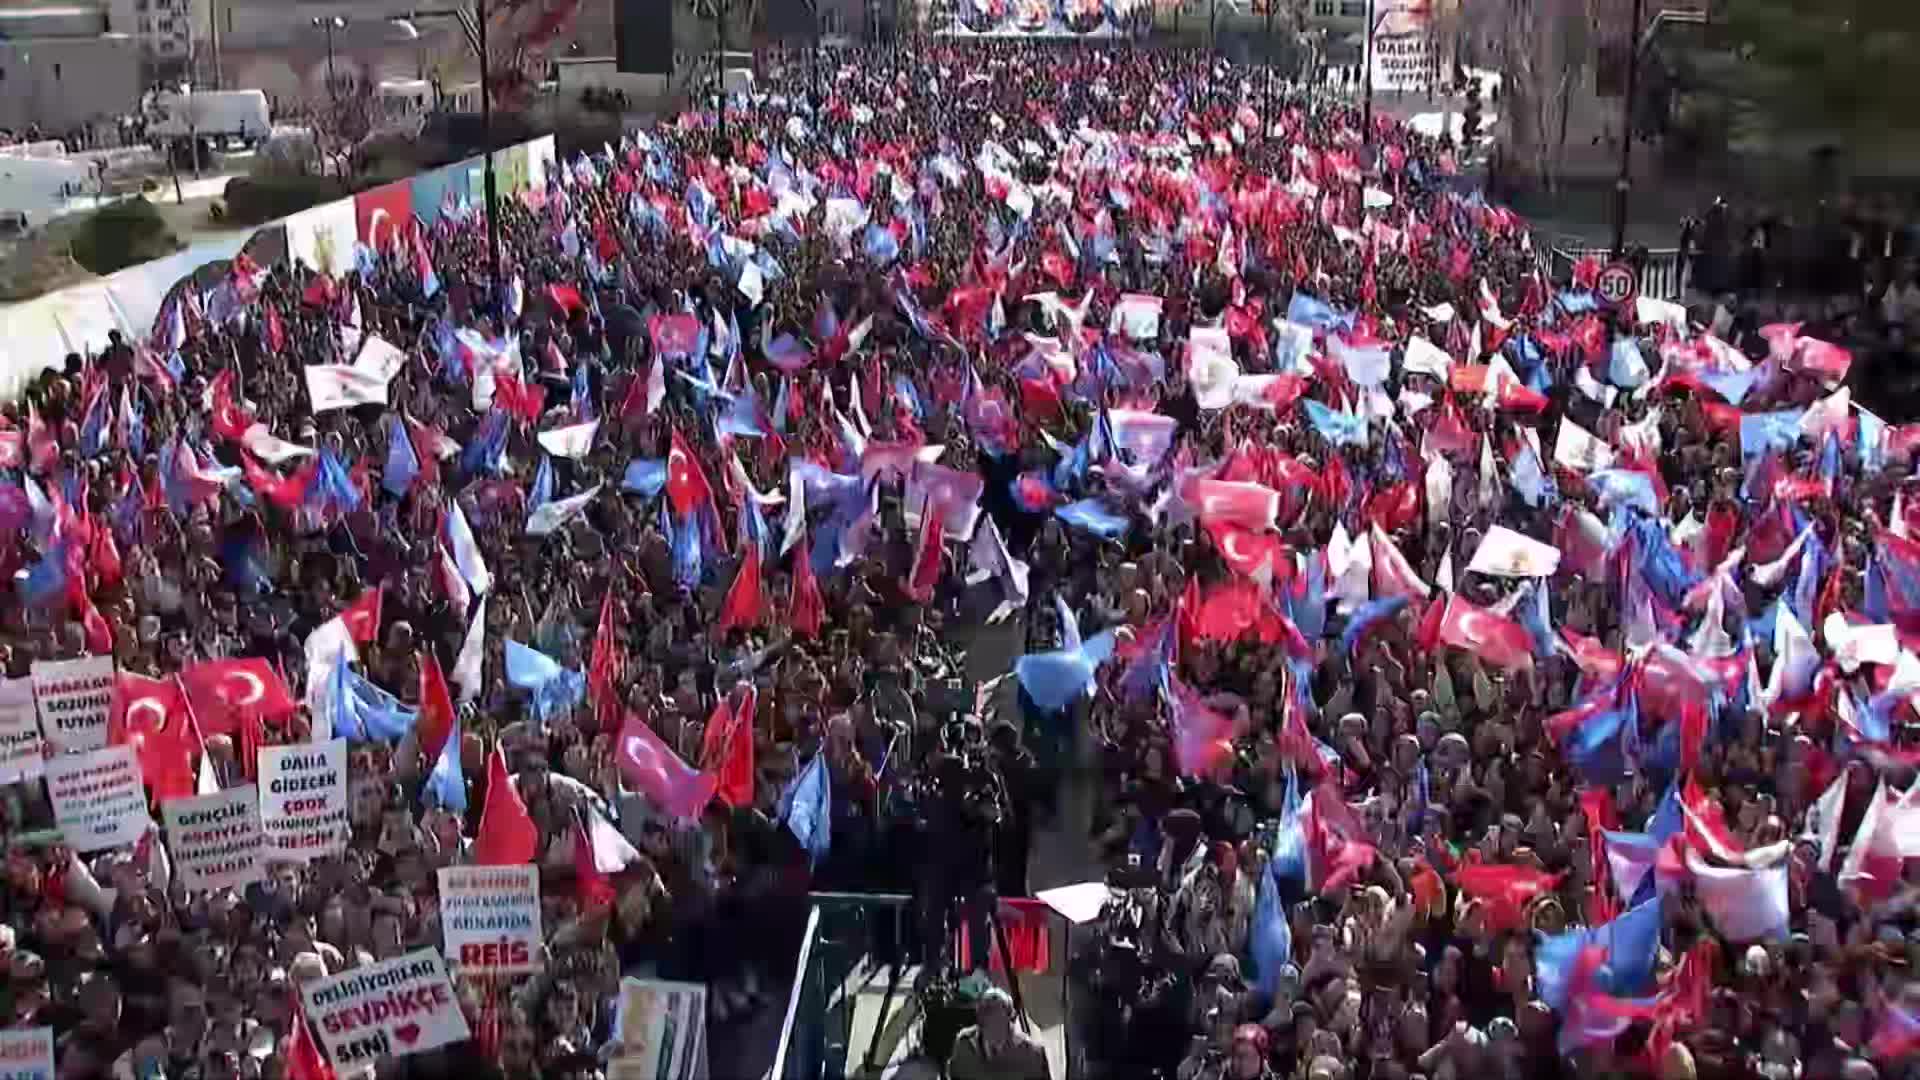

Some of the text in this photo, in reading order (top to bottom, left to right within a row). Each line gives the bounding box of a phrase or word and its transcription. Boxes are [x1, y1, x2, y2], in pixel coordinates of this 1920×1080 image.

[1602, 275, 1628, 296] 50
[461, 935, 528, 965] REİS
[322, 983, 448, 1033] SEVDİKÇE
[336, 1030, 389, 1063] SENİ
